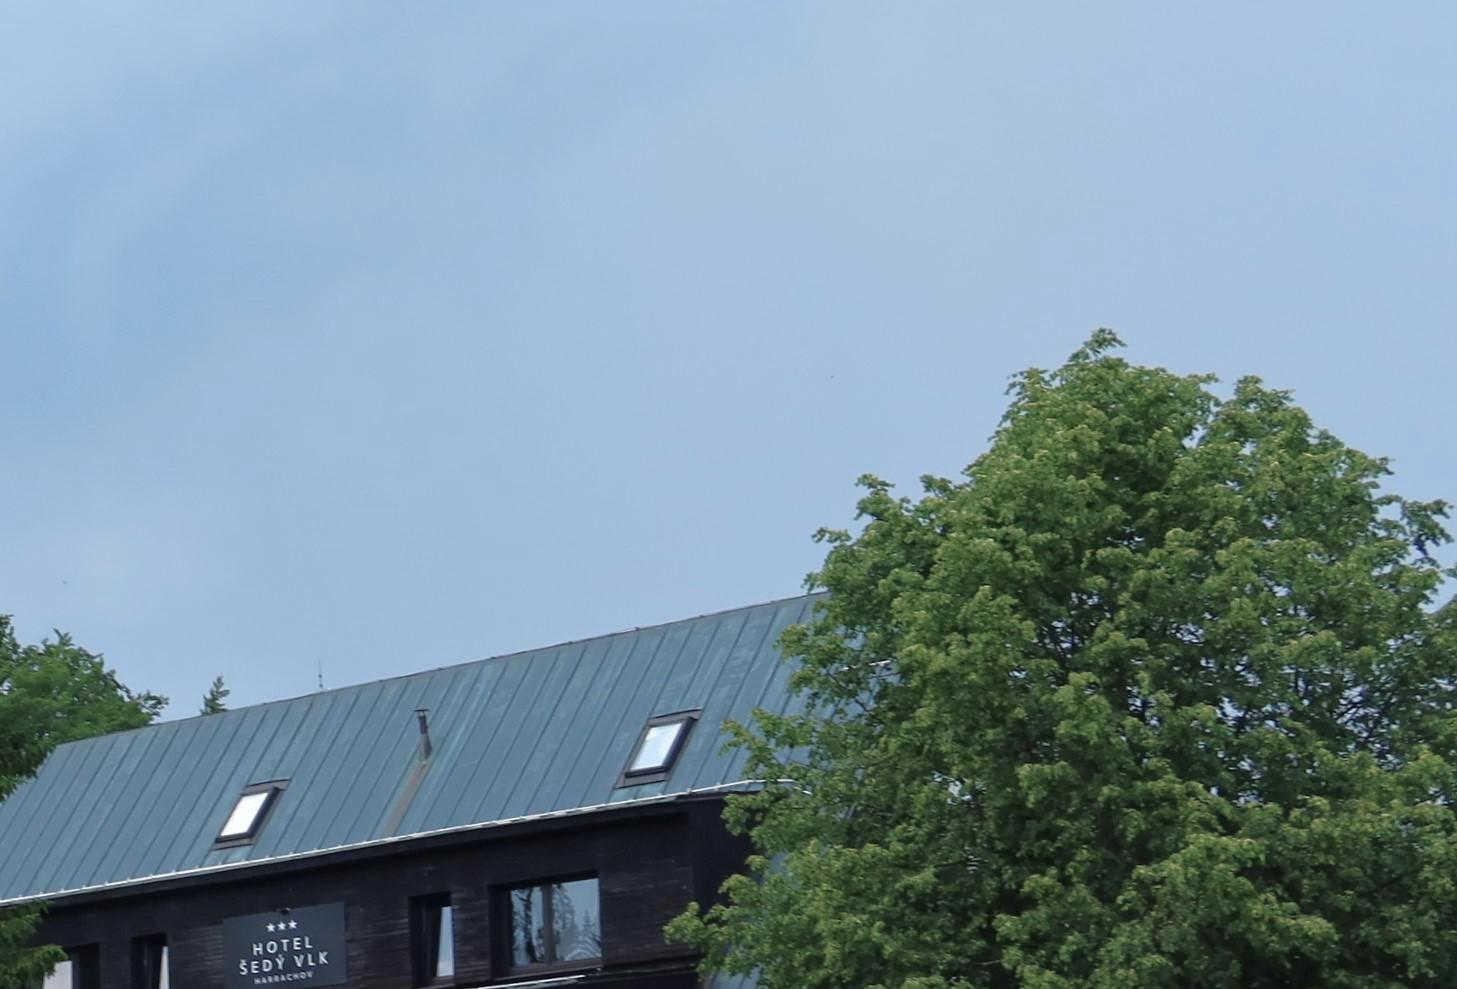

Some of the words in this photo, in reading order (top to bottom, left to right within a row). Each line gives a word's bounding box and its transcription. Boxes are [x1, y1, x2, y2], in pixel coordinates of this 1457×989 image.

[252, 936, 313, 956] HOTEL
[239, 954, 285, 976] ŠEDÝ
[293, 951, 329, 968] VLK
